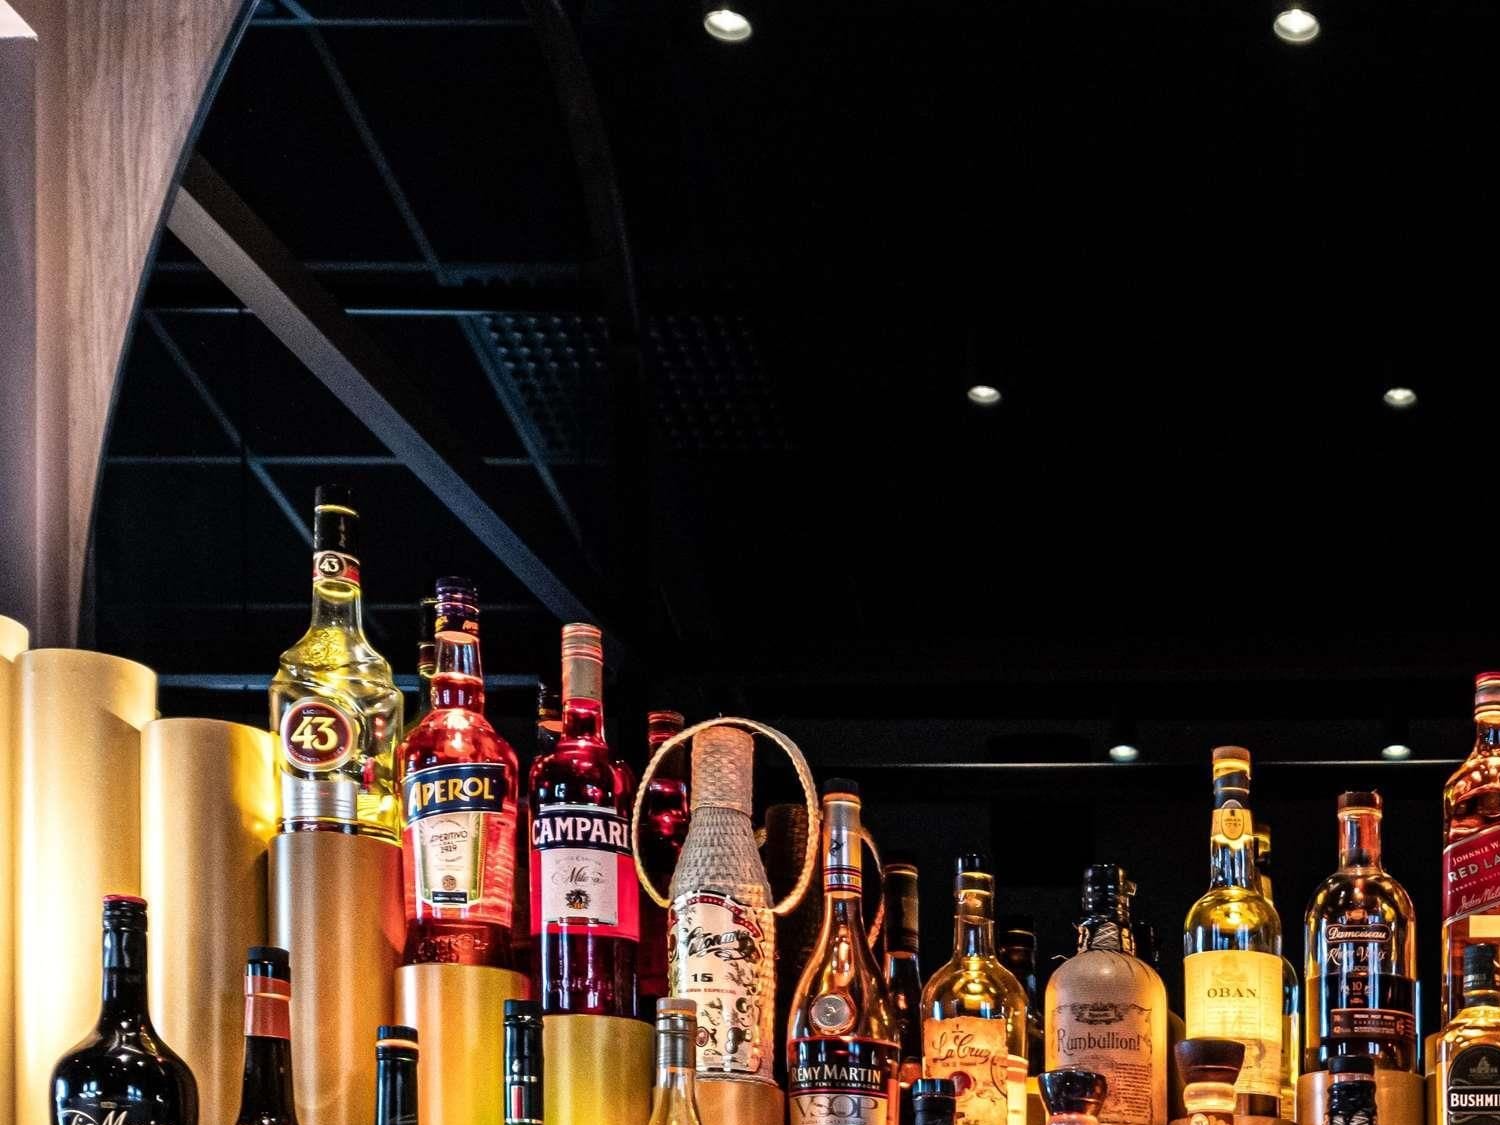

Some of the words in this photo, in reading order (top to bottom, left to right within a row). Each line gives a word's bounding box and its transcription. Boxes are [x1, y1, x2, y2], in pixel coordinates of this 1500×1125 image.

[290, 716, 338, 751] 43
[407, 776, 495, 812] APEROL
[532, 816, 628, 848] CAMPARI
[1452, 846, 1490, 866] JOHNNIE
[1448, 863, 1479, 883] RED
[692, 973, 713, 983] 15
[1206, 986, 1258, 999] OBAN
[823, 1064, 881, 1083] MARTIN
[795, 1095, 878, 1119] VSOP
